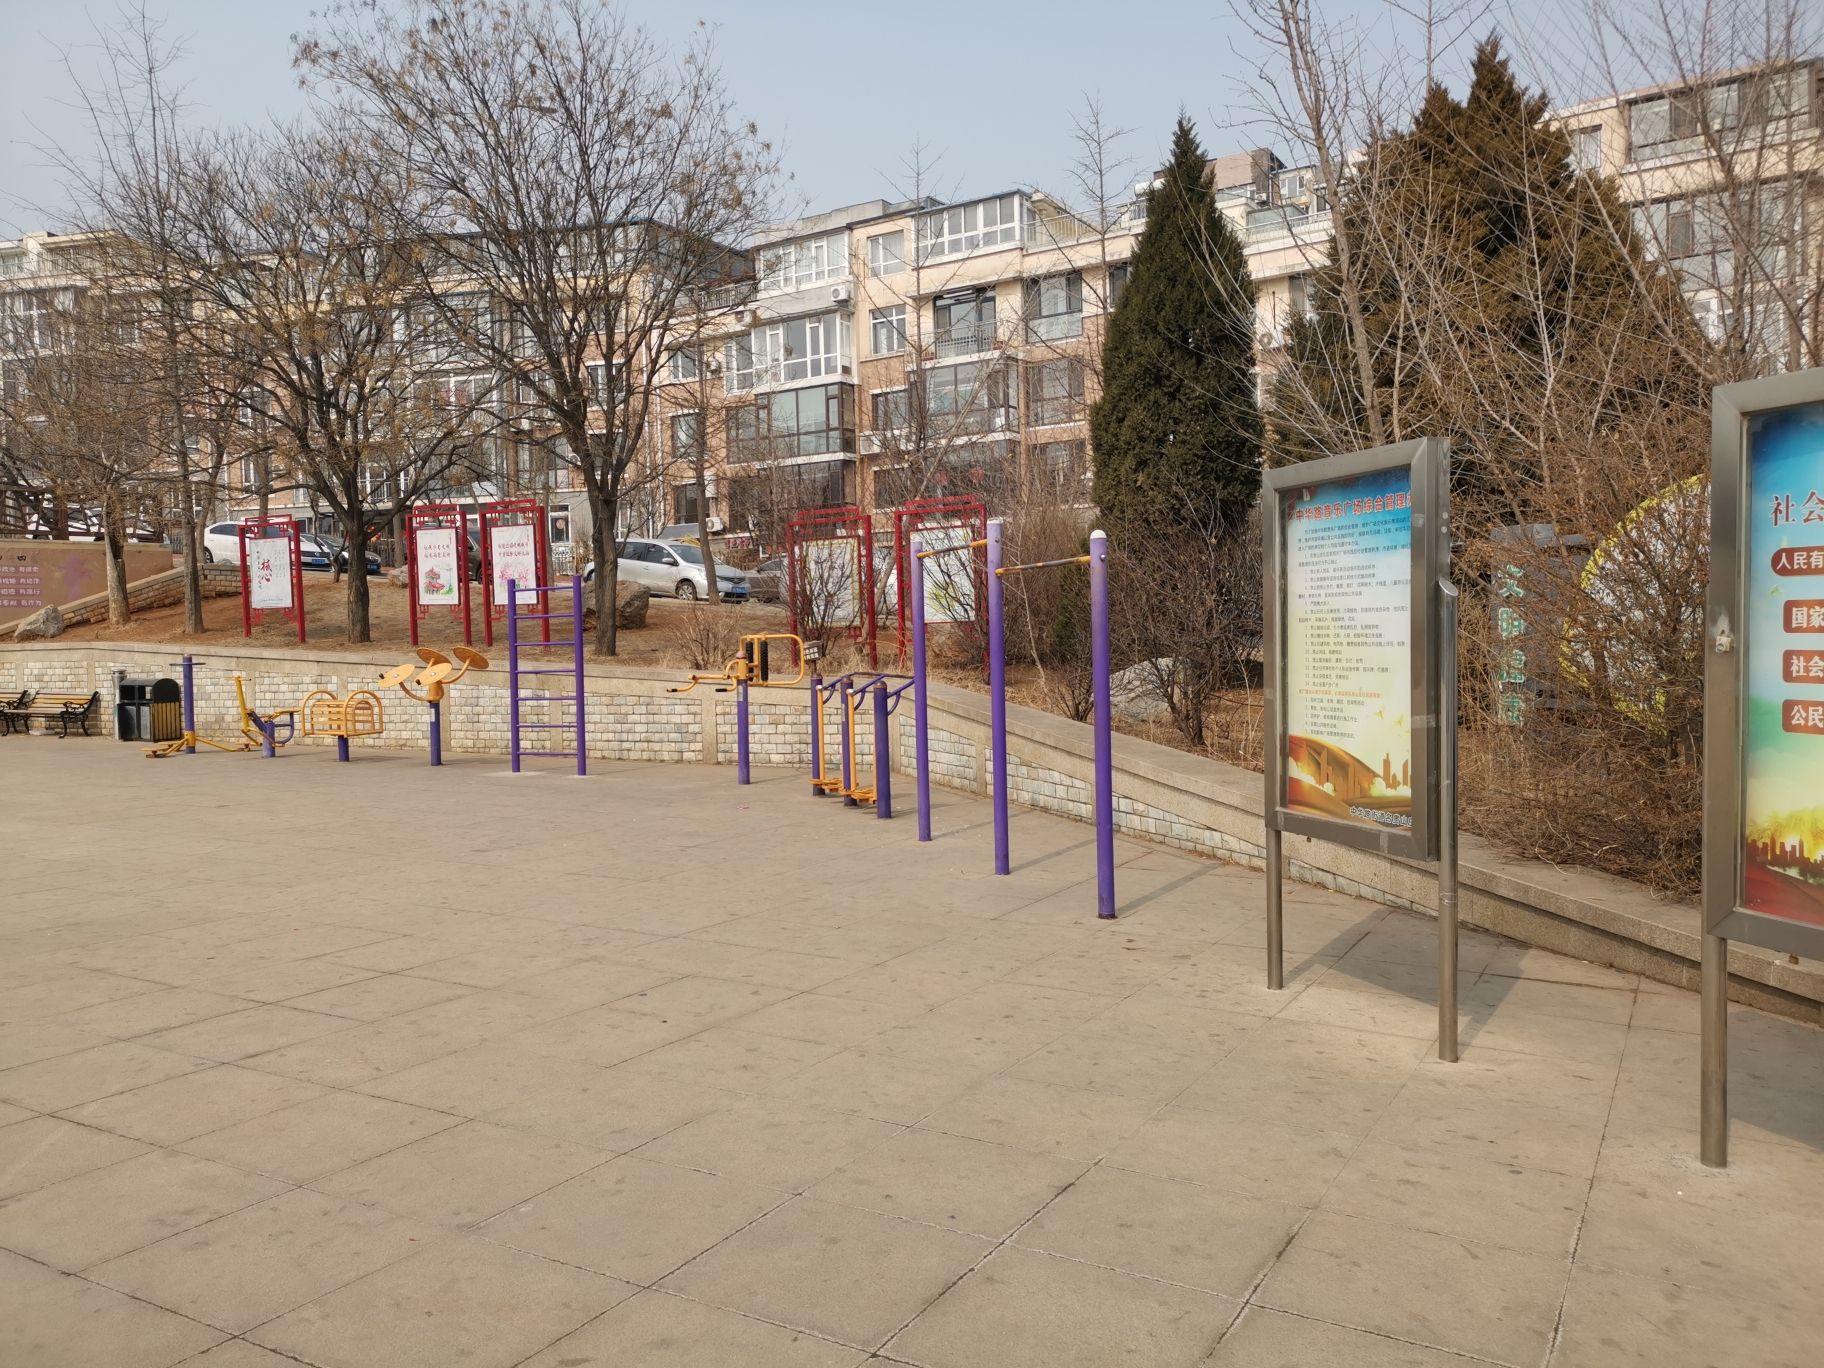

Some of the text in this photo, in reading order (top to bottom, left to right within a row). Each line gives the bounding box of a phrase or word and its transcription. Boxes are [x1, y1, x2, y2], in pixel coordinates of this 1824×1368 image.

[1770, 490, 1824, 528] 社会
[1776, 551, 1824, 570] 人民有
[1791, 606, 1824, 629] 国家
[1790, 655, 1824, 678] 社会
[1789, 704, 1824, 728] 公民
